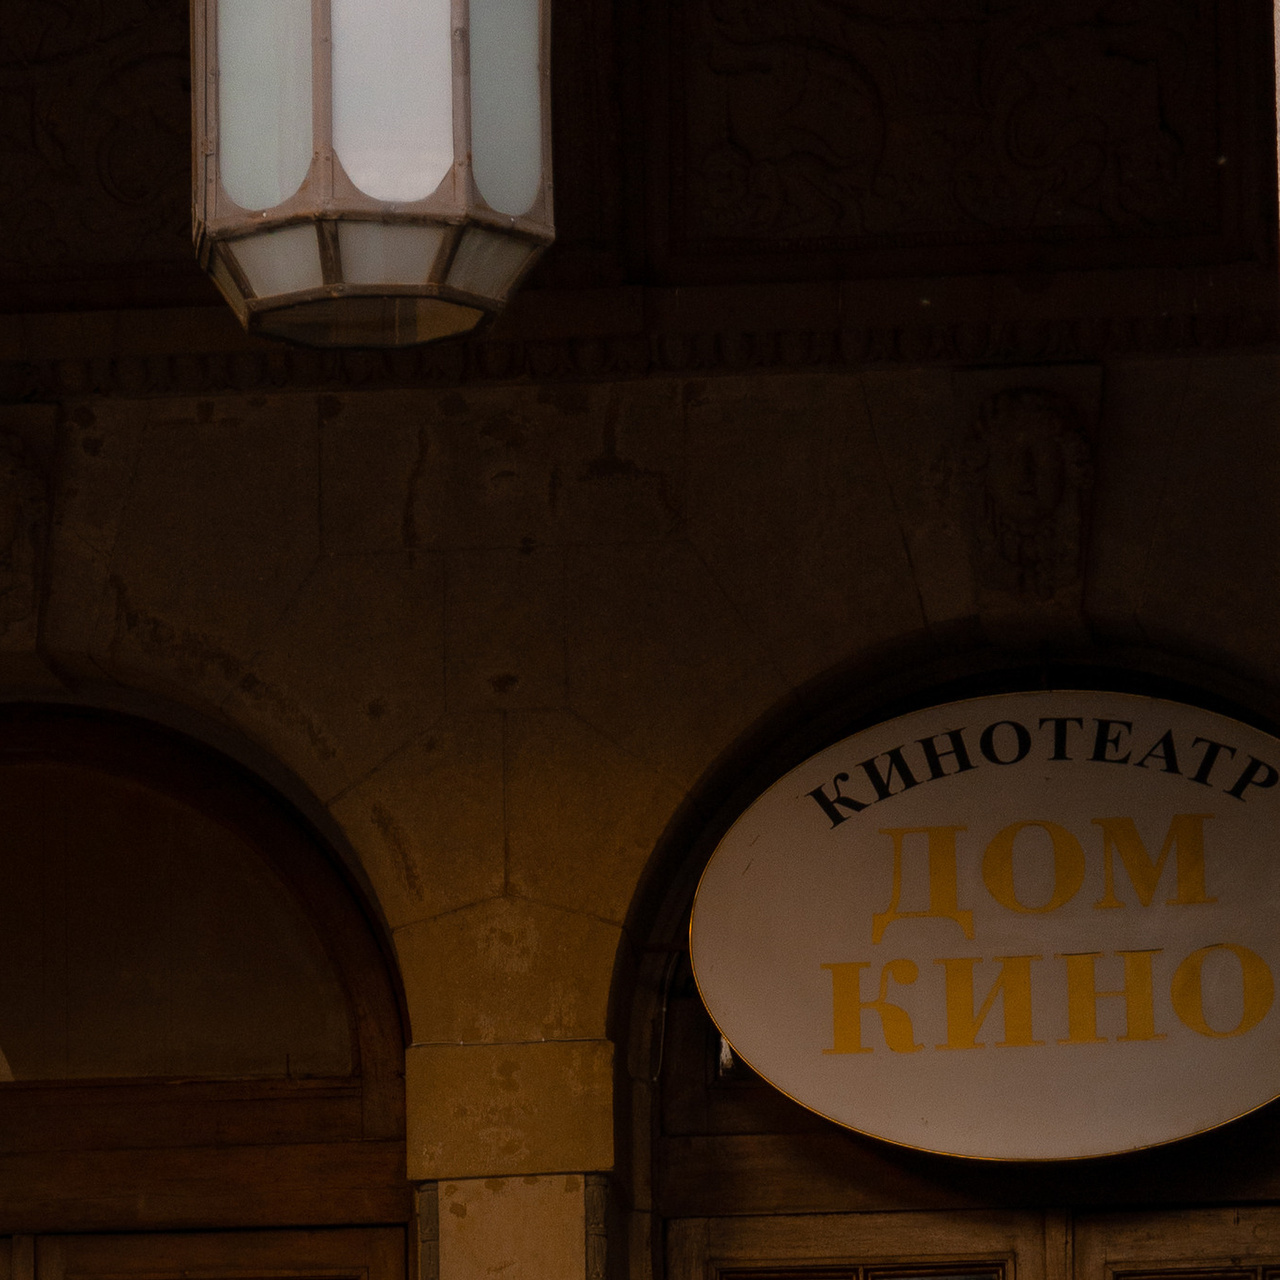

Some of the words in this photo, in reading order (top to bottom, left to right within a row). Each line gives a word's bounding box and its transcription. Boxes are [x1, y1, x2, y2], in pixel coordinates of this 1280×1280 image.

[804, 717, 1280, 829] КИНОТЕАТР
[872, 813, 1219, 944] ДОМ
[821, 942, 1275, 1055] КИНО
